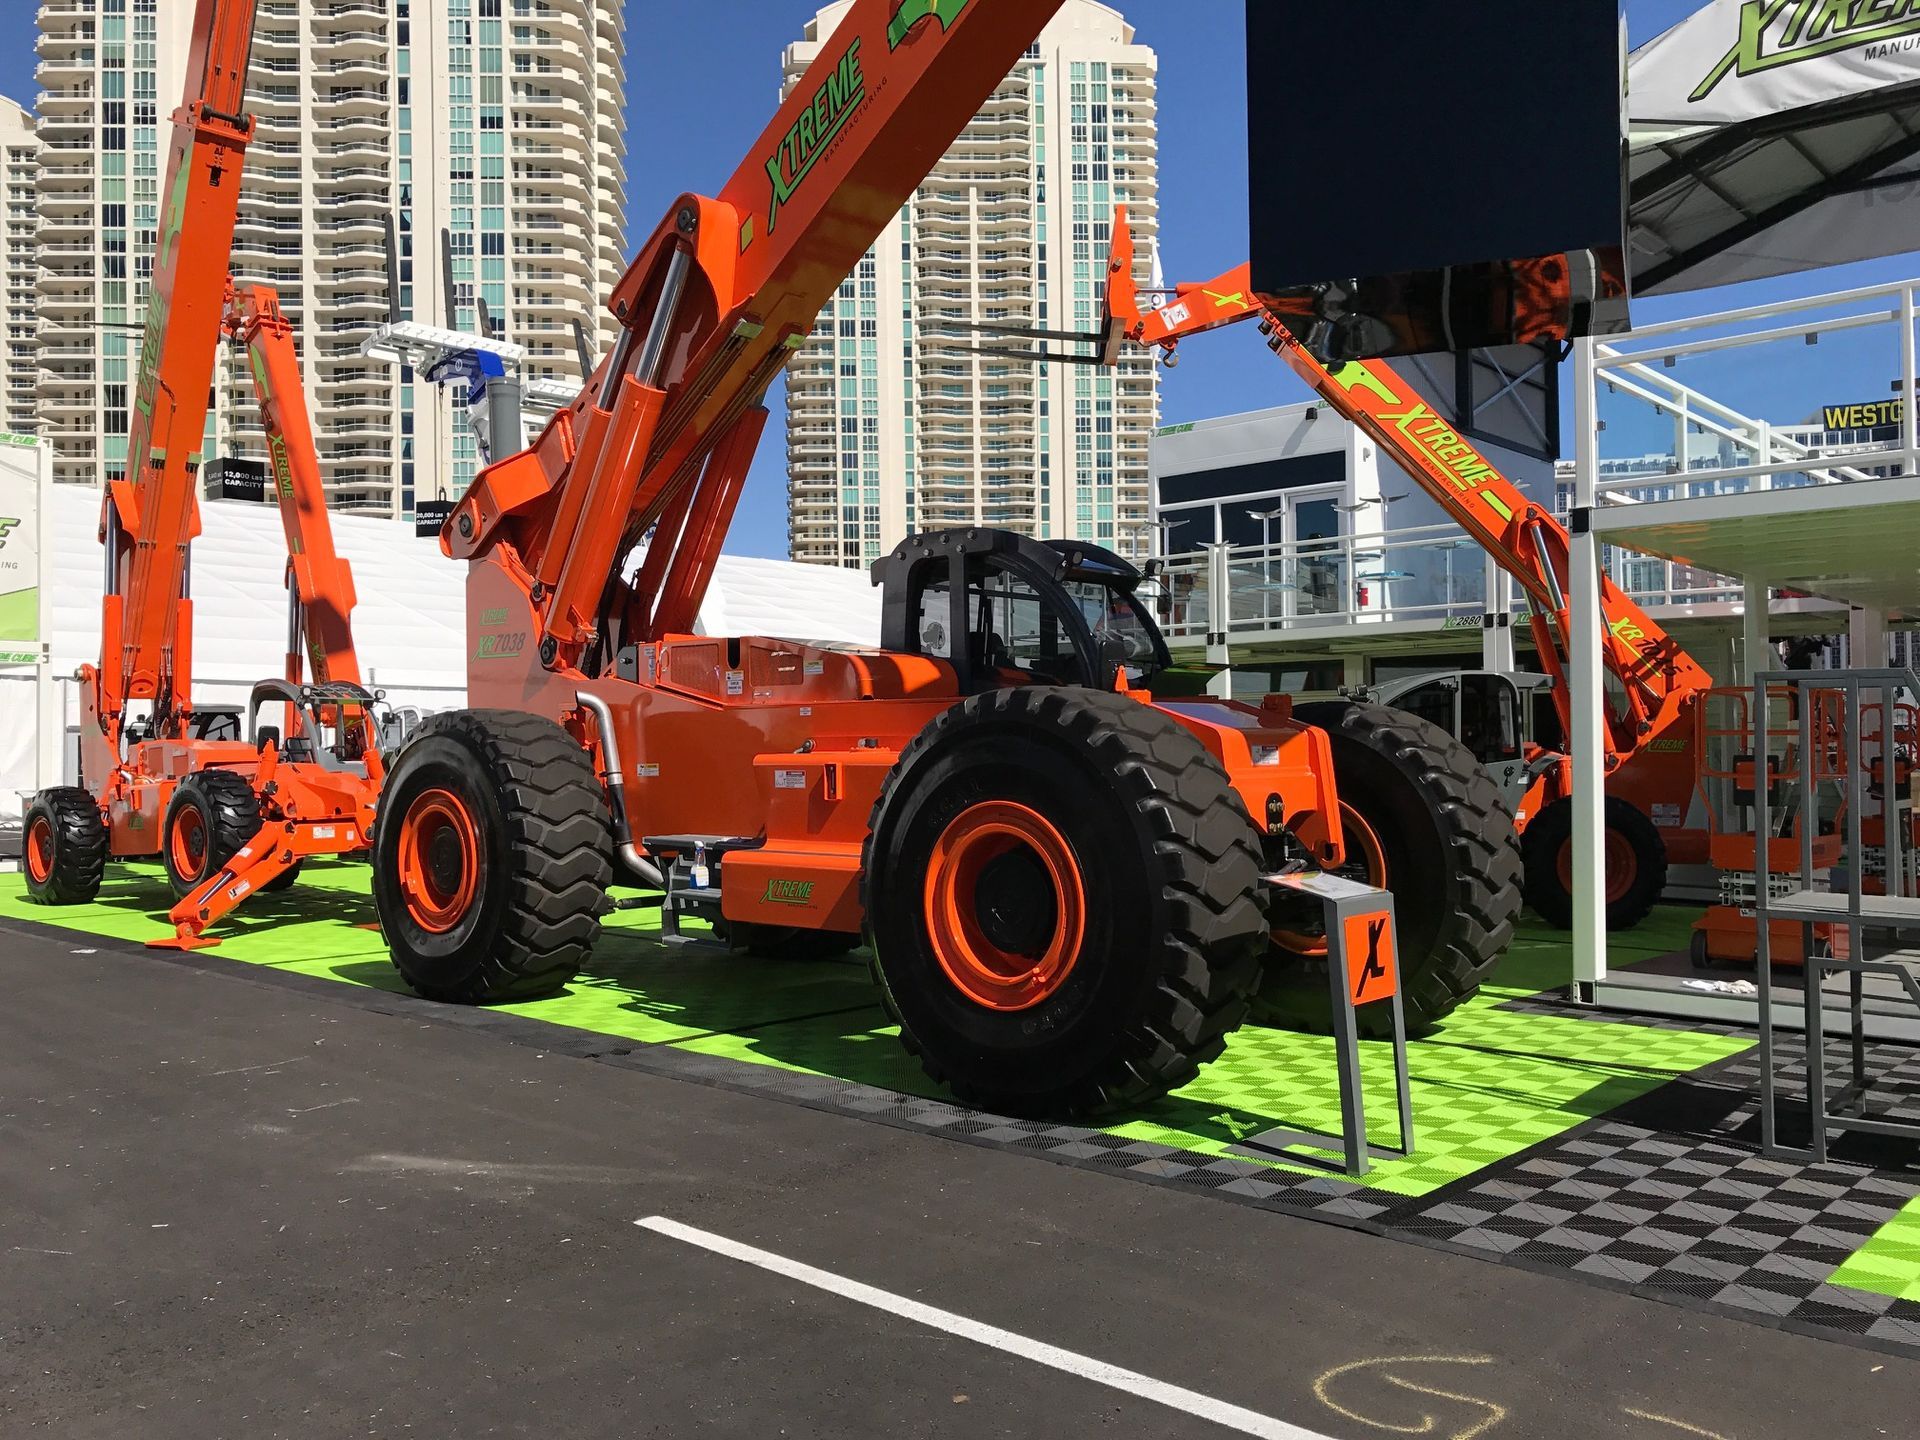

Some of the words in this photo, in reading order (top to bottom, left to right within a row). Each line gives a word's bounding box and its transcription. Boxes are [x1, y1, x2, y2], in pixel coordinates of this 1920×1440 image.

[765, 36, 865, 236] XTREME
[824, 77, 888, 163] MANUFACTURING
[224, 470, 250, 479] 12,000
[268, 433, 295, 499] XTREME
[1375, 402, 1501, 492] XTREME
[224, 478, 262, 488] CAPACITY
[1421, 456, 1476, 509] MANUFACTURING
[760, 879, 815, 905] XTREME
